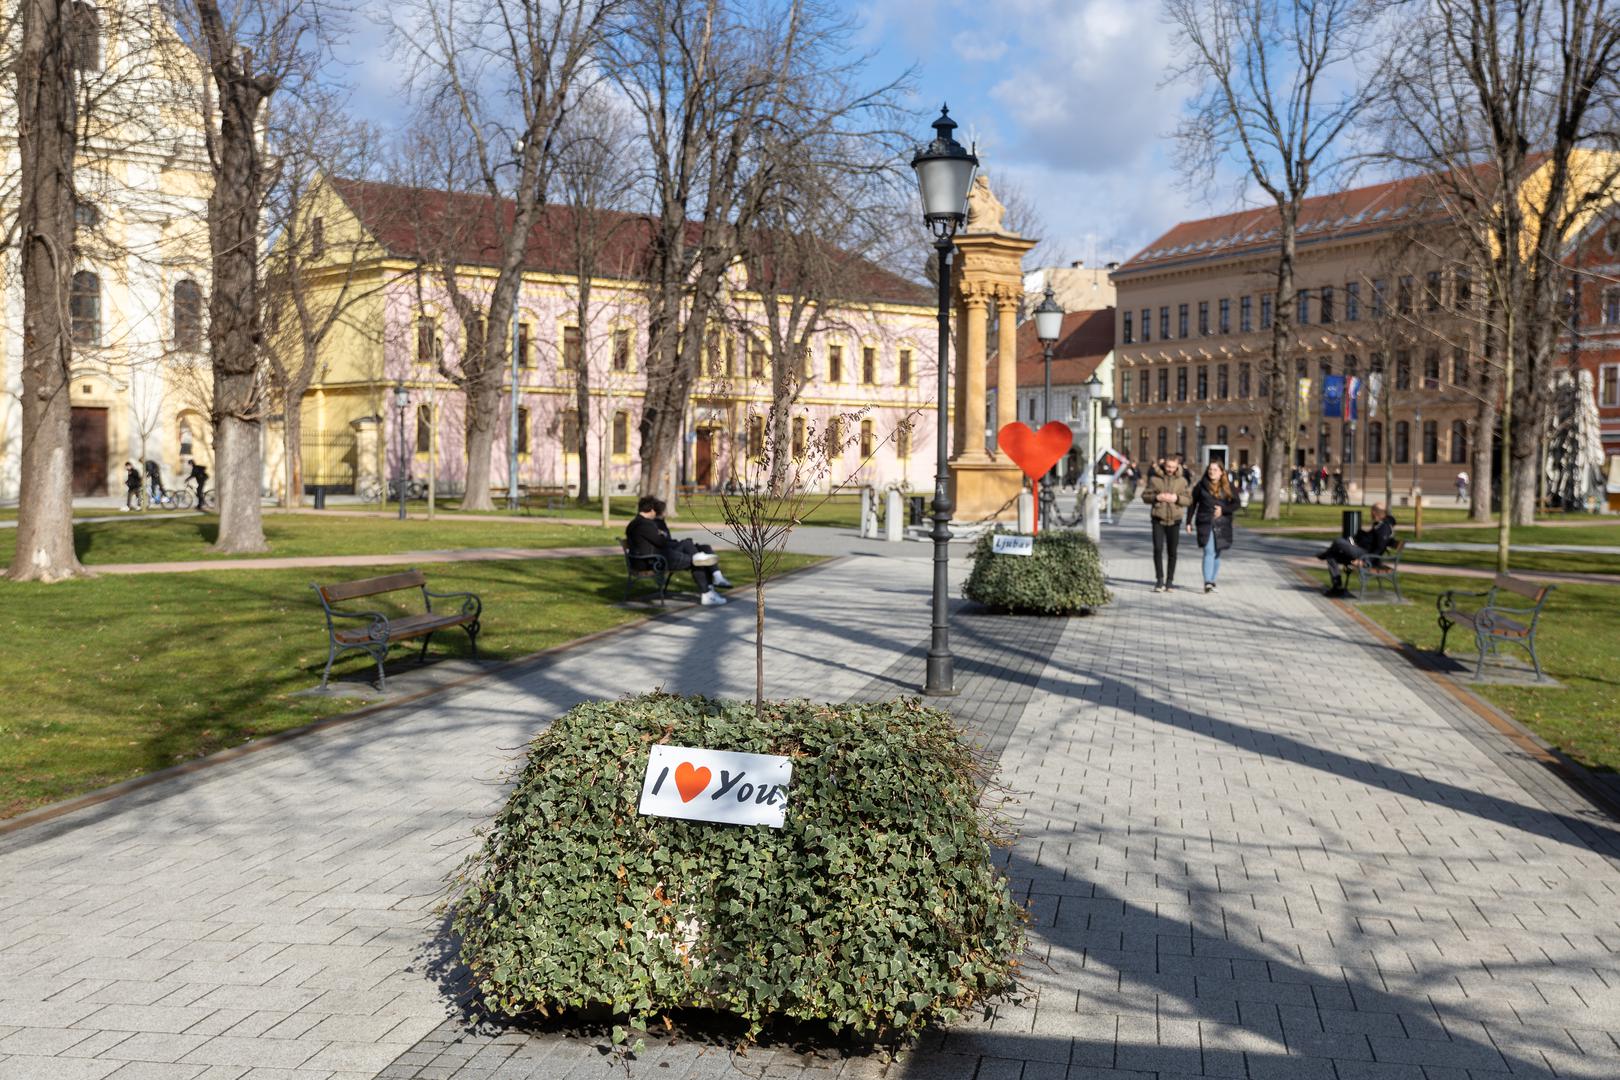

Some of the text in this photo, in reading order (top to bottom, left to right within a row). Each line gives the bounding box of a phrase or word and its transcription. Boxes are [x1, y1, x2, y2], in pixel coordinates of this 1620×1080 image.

[996, 538, 1031, 551] Ljubav
[651, 766, 779, 806] I You
